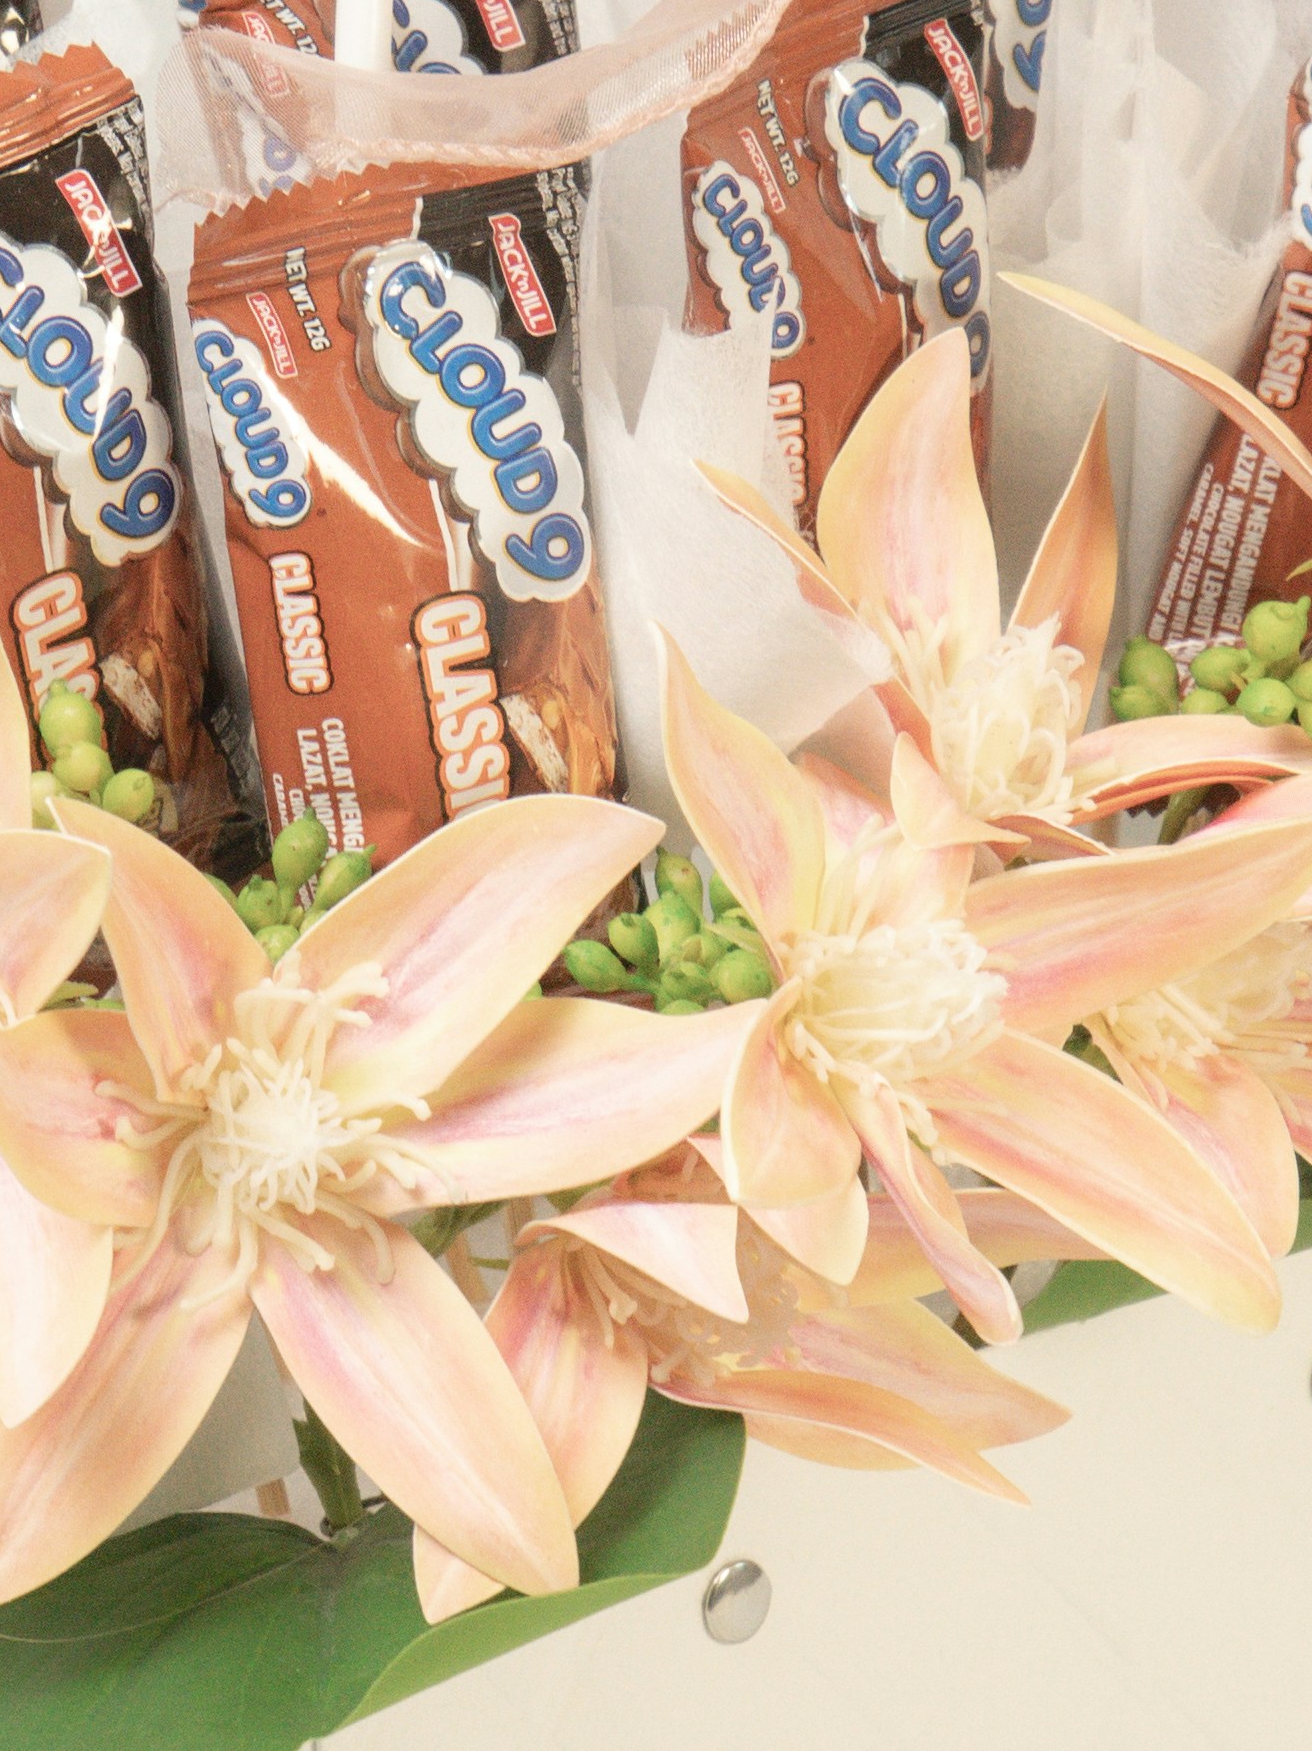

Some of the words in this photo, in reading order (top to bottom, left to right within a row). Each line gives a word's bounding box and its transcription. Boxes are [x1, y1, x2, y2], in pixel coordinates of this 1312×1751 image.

[778, 151, 800, 187] 12G
[288, 282, 316, 317] WT.
[303, 316, 331, 351] 12G
[1253, 455, 1282, 503] KLAT
[1208, 495, 1245, 569] NOUGAT
[270, 553, 332, 693] CLASSIC
[321, 717, 355, 790] COKLAT
